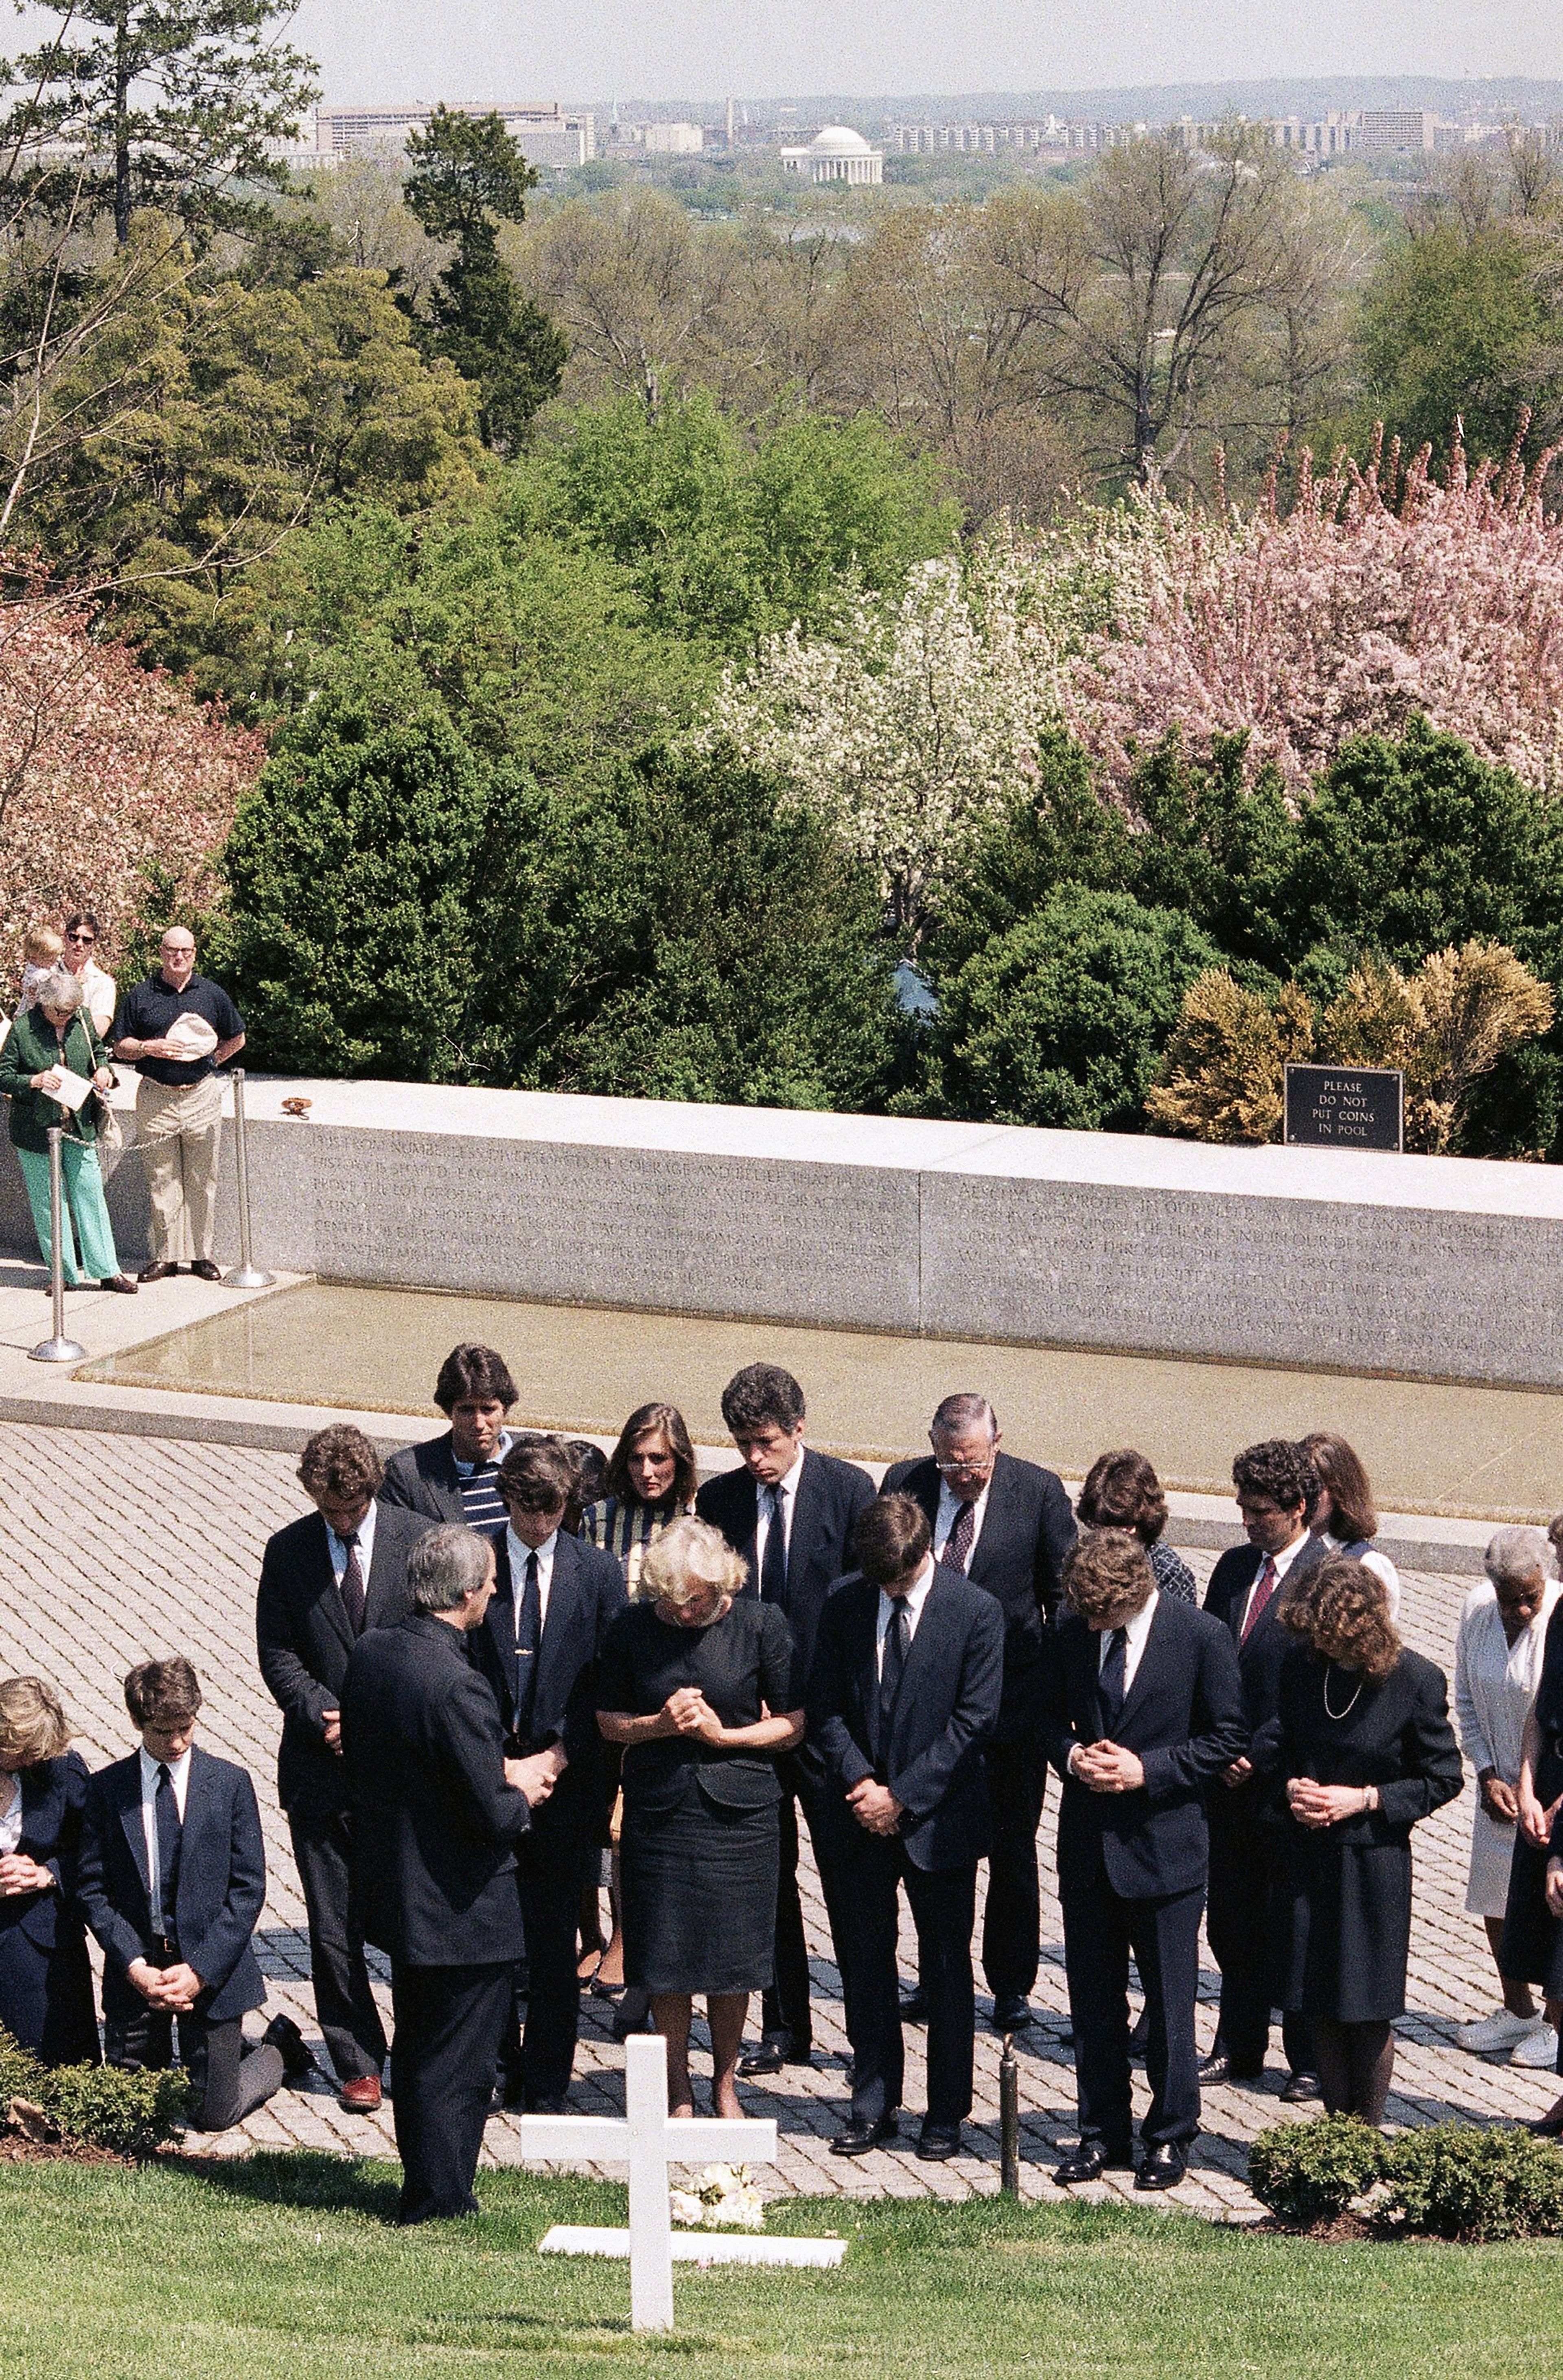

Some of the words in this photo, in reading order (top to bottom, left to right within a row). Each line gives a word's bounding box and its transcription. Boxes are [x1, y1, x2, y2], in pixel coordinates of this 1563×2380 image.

[1324, 1081, 1363, 1093] PLEASE
[1320, 1095, 1336, 1105] DO
[1343, 1097, 1368, 1107] NOT
[1312, 1109, 1331, 1119] PUT
[1339, 1111, 1374, 1122] COINS
[1319, 1124, 1331, 1133] IN
[1339, 1125, 1367, 1136] POOL
